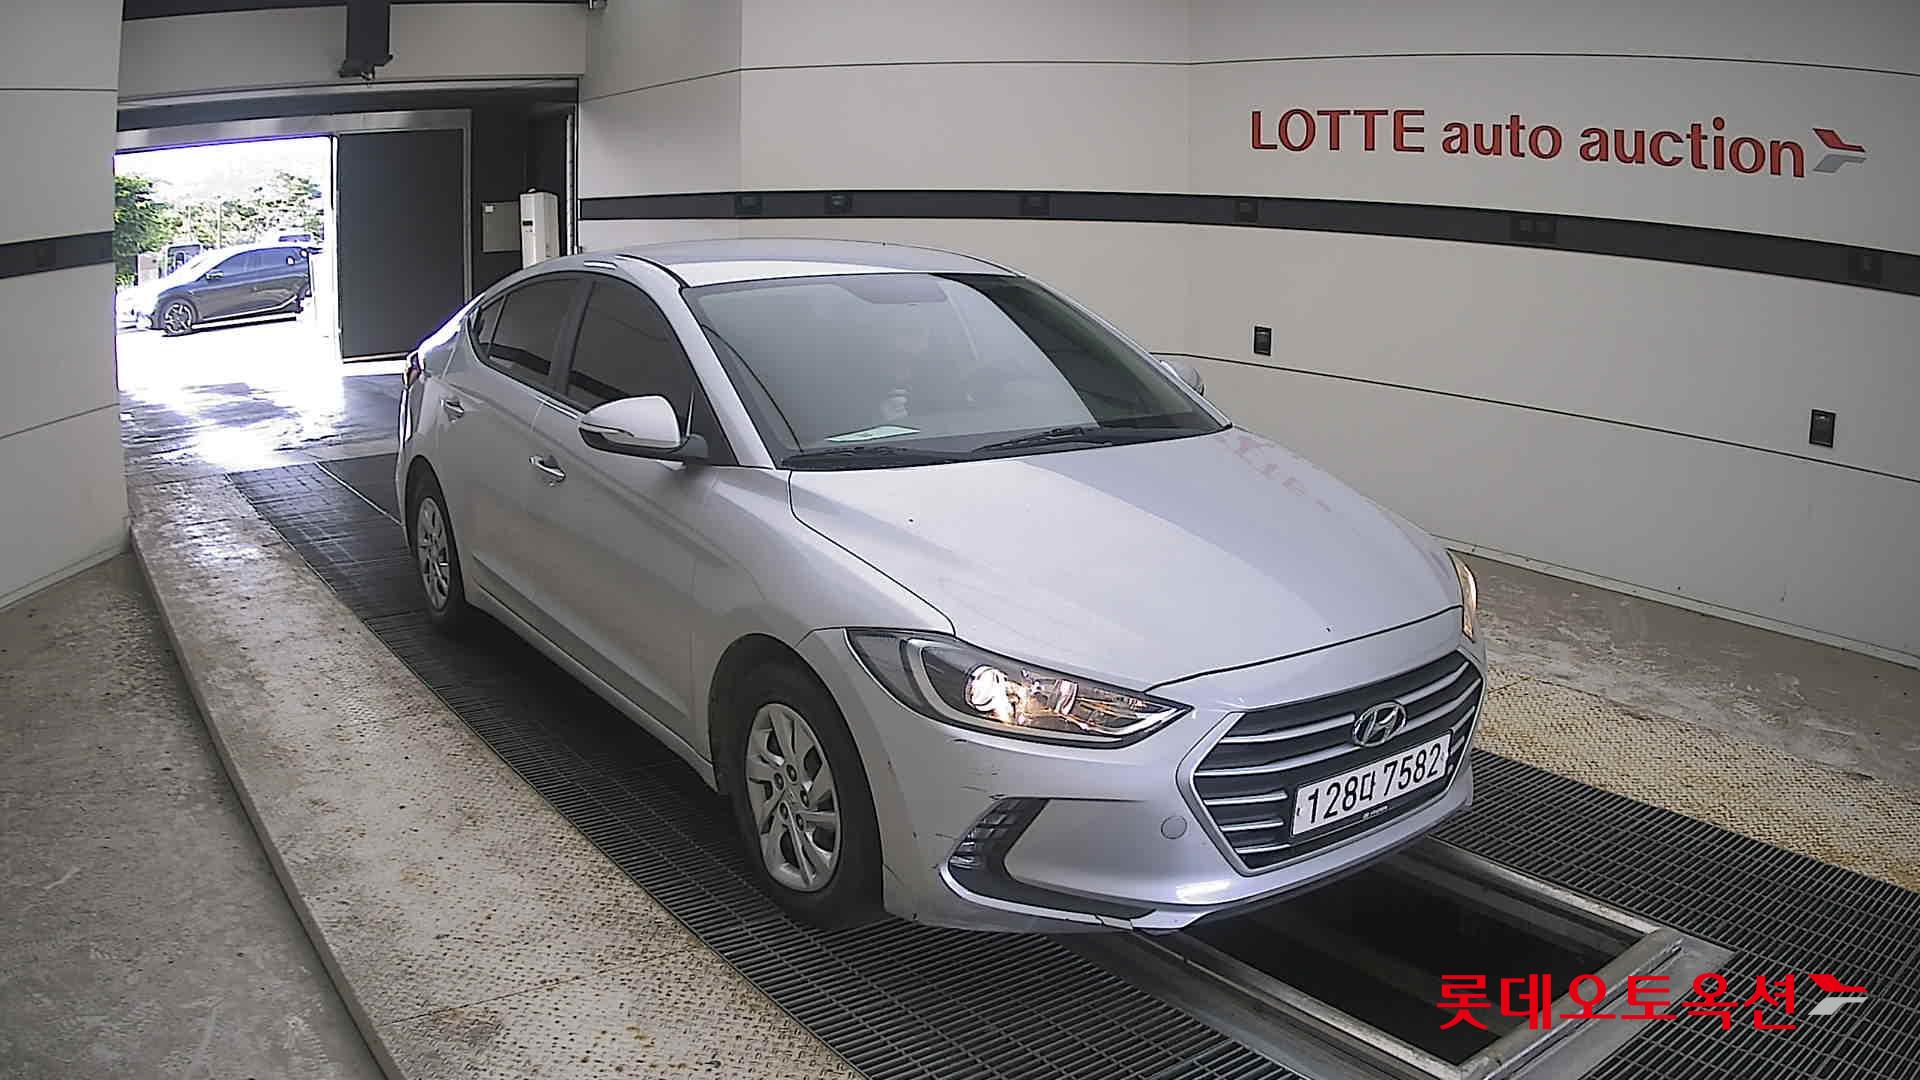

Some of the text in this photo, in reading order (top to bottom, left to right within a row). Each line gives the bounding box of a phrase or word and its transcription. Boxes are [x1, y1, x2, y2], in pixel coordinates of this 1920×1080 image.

[1250, 108, 1806, 178] LOTTE auto auction
[1307, 742, 1442, 825] 128다 7582
